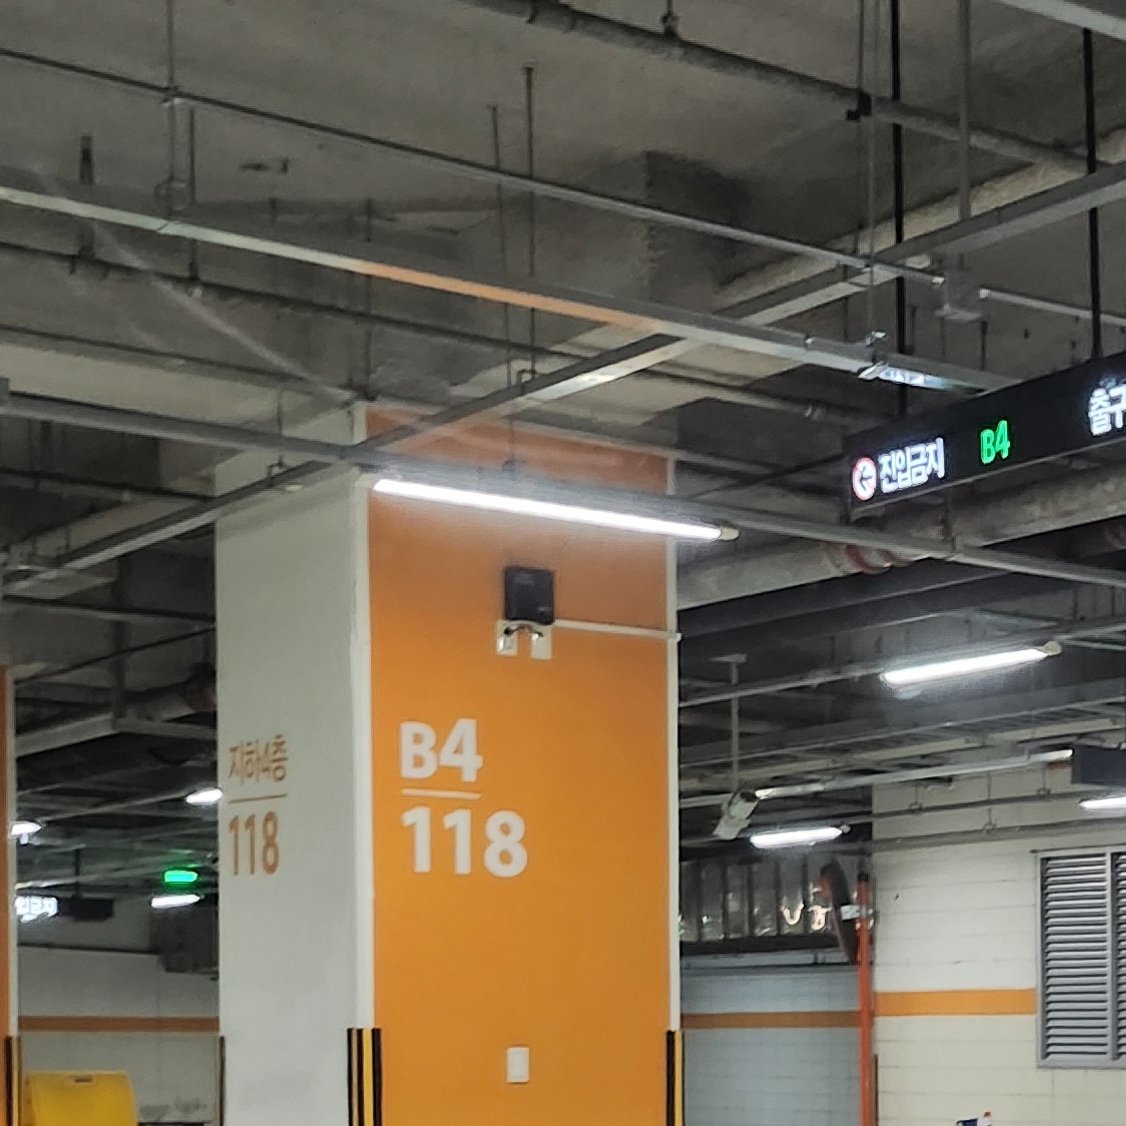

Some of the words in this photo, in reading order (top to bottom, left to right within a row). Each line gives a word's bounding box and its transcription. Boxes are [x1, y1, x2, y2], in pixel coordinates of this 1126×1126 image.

[877, 437, 946, 493] 진입금지
[979, 419, 1011, 465] B4
[399, 717, 484, 783] B4
[227, 810, 281, 876] 118
[401, 805, 528, 878] 118
